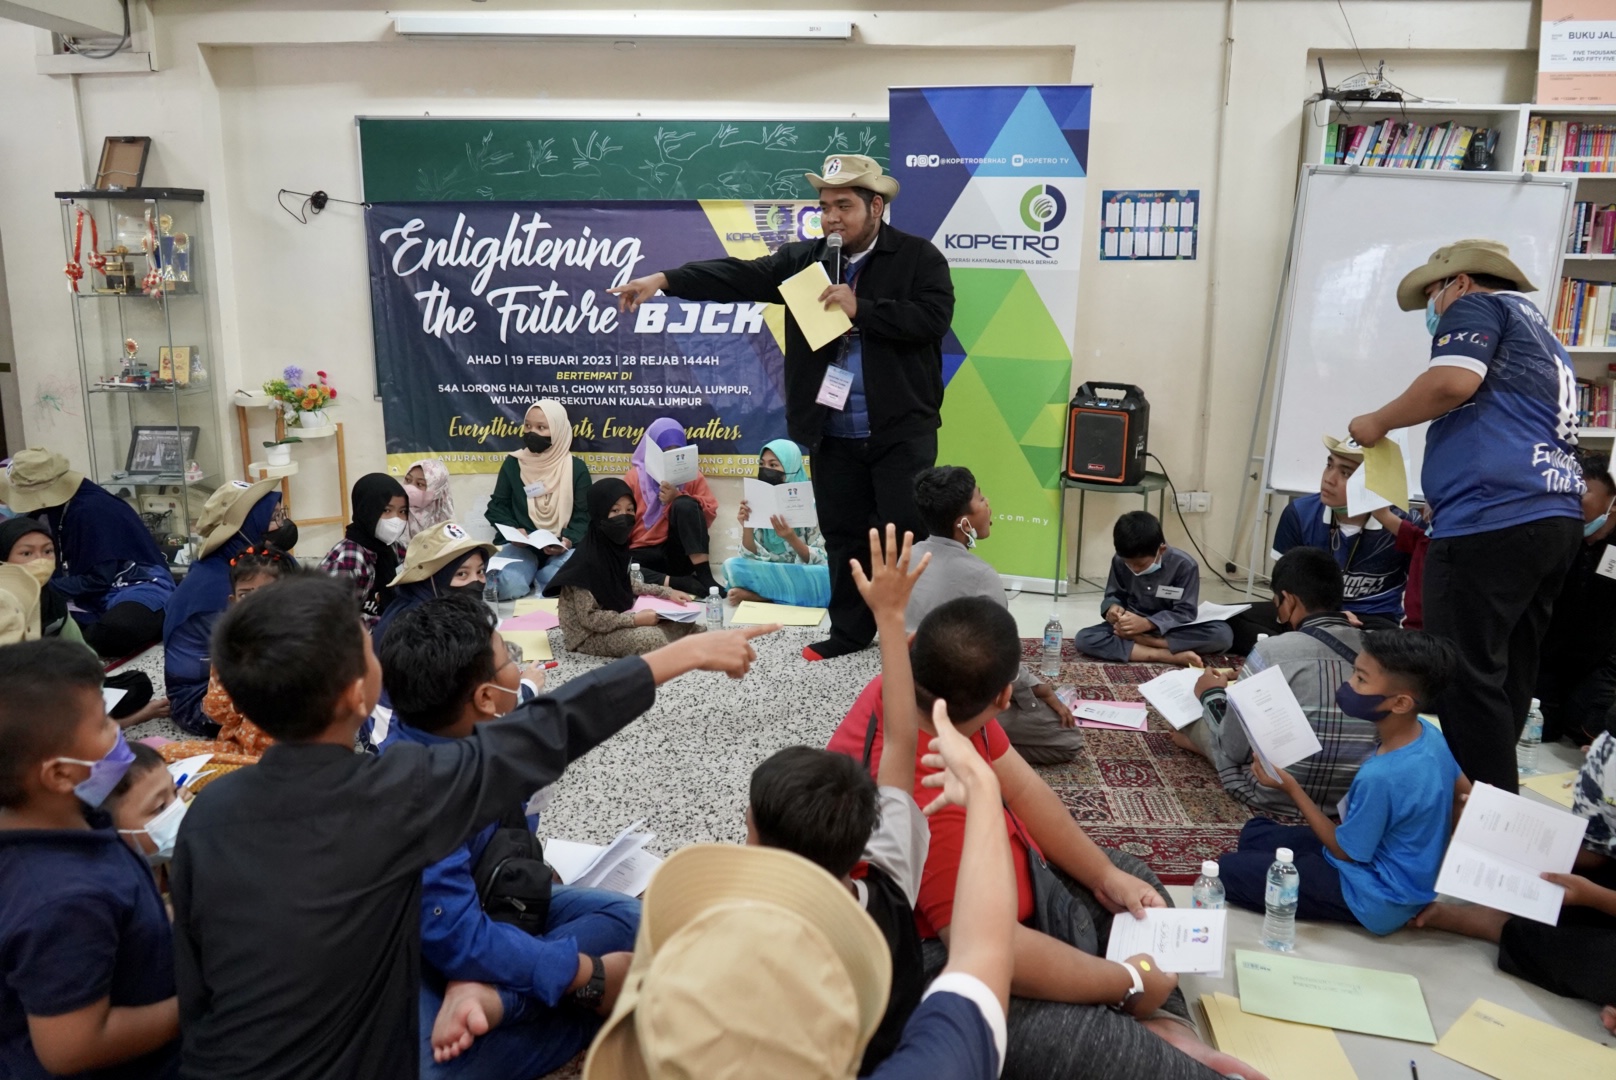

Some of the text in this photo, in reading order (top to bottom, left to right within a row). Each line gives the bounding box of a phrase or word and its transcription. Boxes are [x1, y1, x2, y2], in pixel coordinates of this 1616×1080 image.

[1568, 31, 1596, 40] BUKU
[1597, 31, 1616, 40] JAL
[939, 157, 1070, 165] @KOPETROBERHAD KOPETRO TV
[944, 233, 1060, 259] KOPETRO
[379, 211, 645, 297] Enlightening
[414, 279, 768, 344] the Future BJCK
[466, 355, 501, 365] AHAD
[511, 355, 524, 365] 19
[527, 355, 579, 365] FEBUARI
[582, 355, 612, 365] 2023
[622, 355, 637, 366] 28
[640, 356, 679, 366] REJAB
[682, 356, 720, 366] 1444H
[556, 371, 633, 381] BERTEMPAT DI
[438, 384, 752, 396] 54A LORONG HAJI TAIB 1, CHOW KIT, 50350 KUALA LUMPUR,
[490, 395, 539, 405] WILAYAH
[619, 397, 656, 406] KUALA
[658, 397, 702, 407] LUMPUR
[449, 415, 525, 444] Everythin
[602, 416, 647, 445] Every
[438, 455, 485, 463] ANJURAN
[588, 454, 631, 464] DENGAN
[585, 464, 630, 472] ERJASAM
[993, 513, 1049, 526] .com.my
